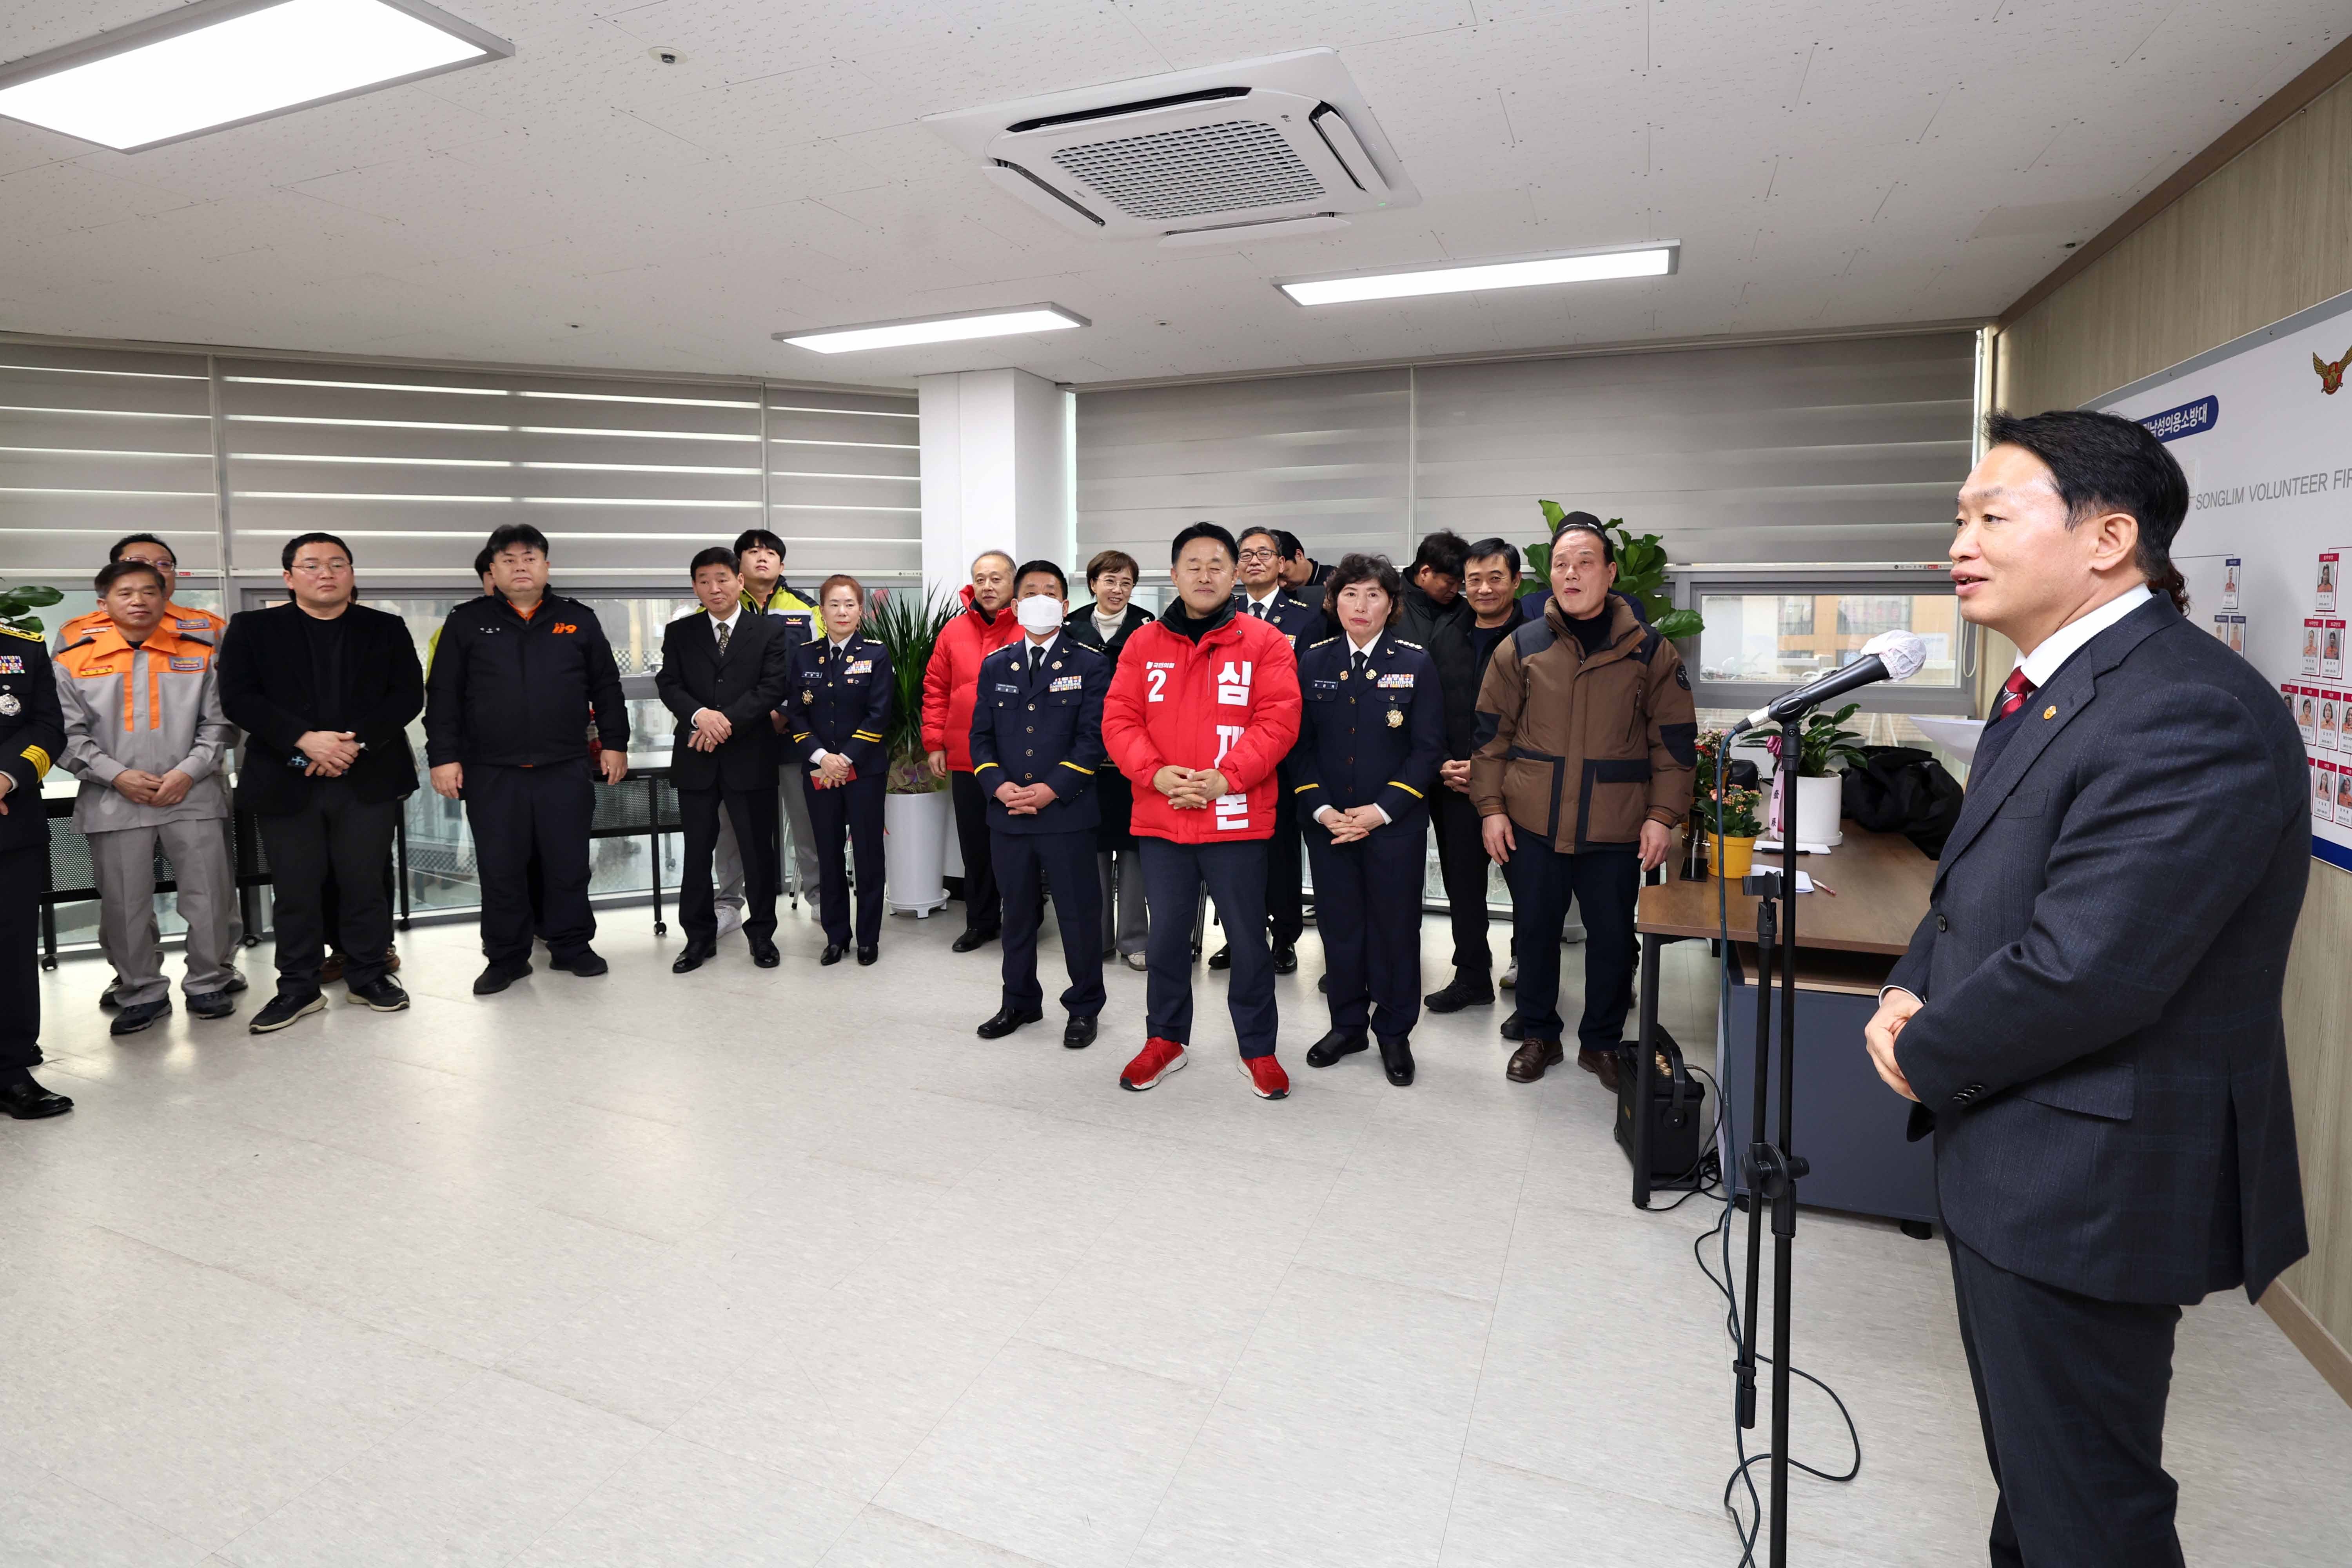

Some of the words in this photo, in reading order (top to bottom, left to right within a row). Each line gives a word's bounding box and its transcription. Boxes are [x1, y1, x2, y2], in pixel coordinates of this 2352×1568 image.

[2196, 487, 2245, 510] SONGLIM
[2249, 472, 2328, 502] VOLUNTEER
[552, 624, 577, 634] 119
[1147, 669, 1167, 702] 2
